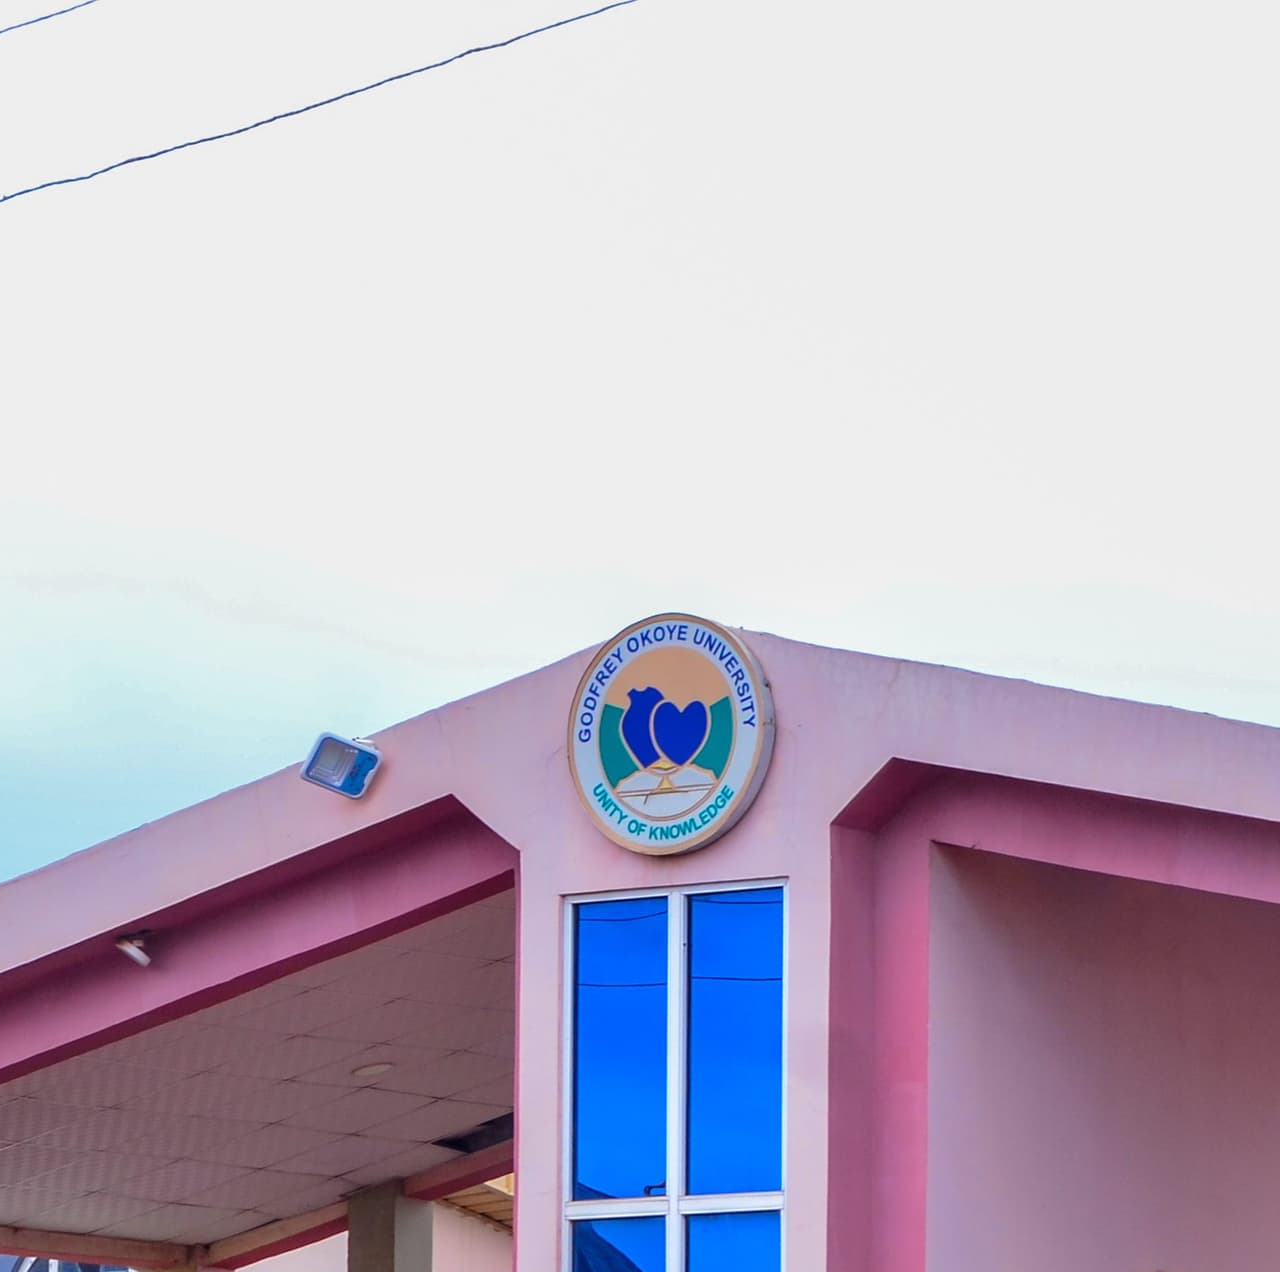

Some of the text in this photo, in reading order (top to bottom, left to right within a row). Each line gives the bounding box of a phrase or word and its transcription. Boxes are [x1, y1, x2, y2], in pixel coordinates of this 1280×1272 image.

[578, 624, 756, 743] GODFREY OKOYE UNIVERSITY
[592, 783, 735, 841] UNITY OF KNOWLEDGE
